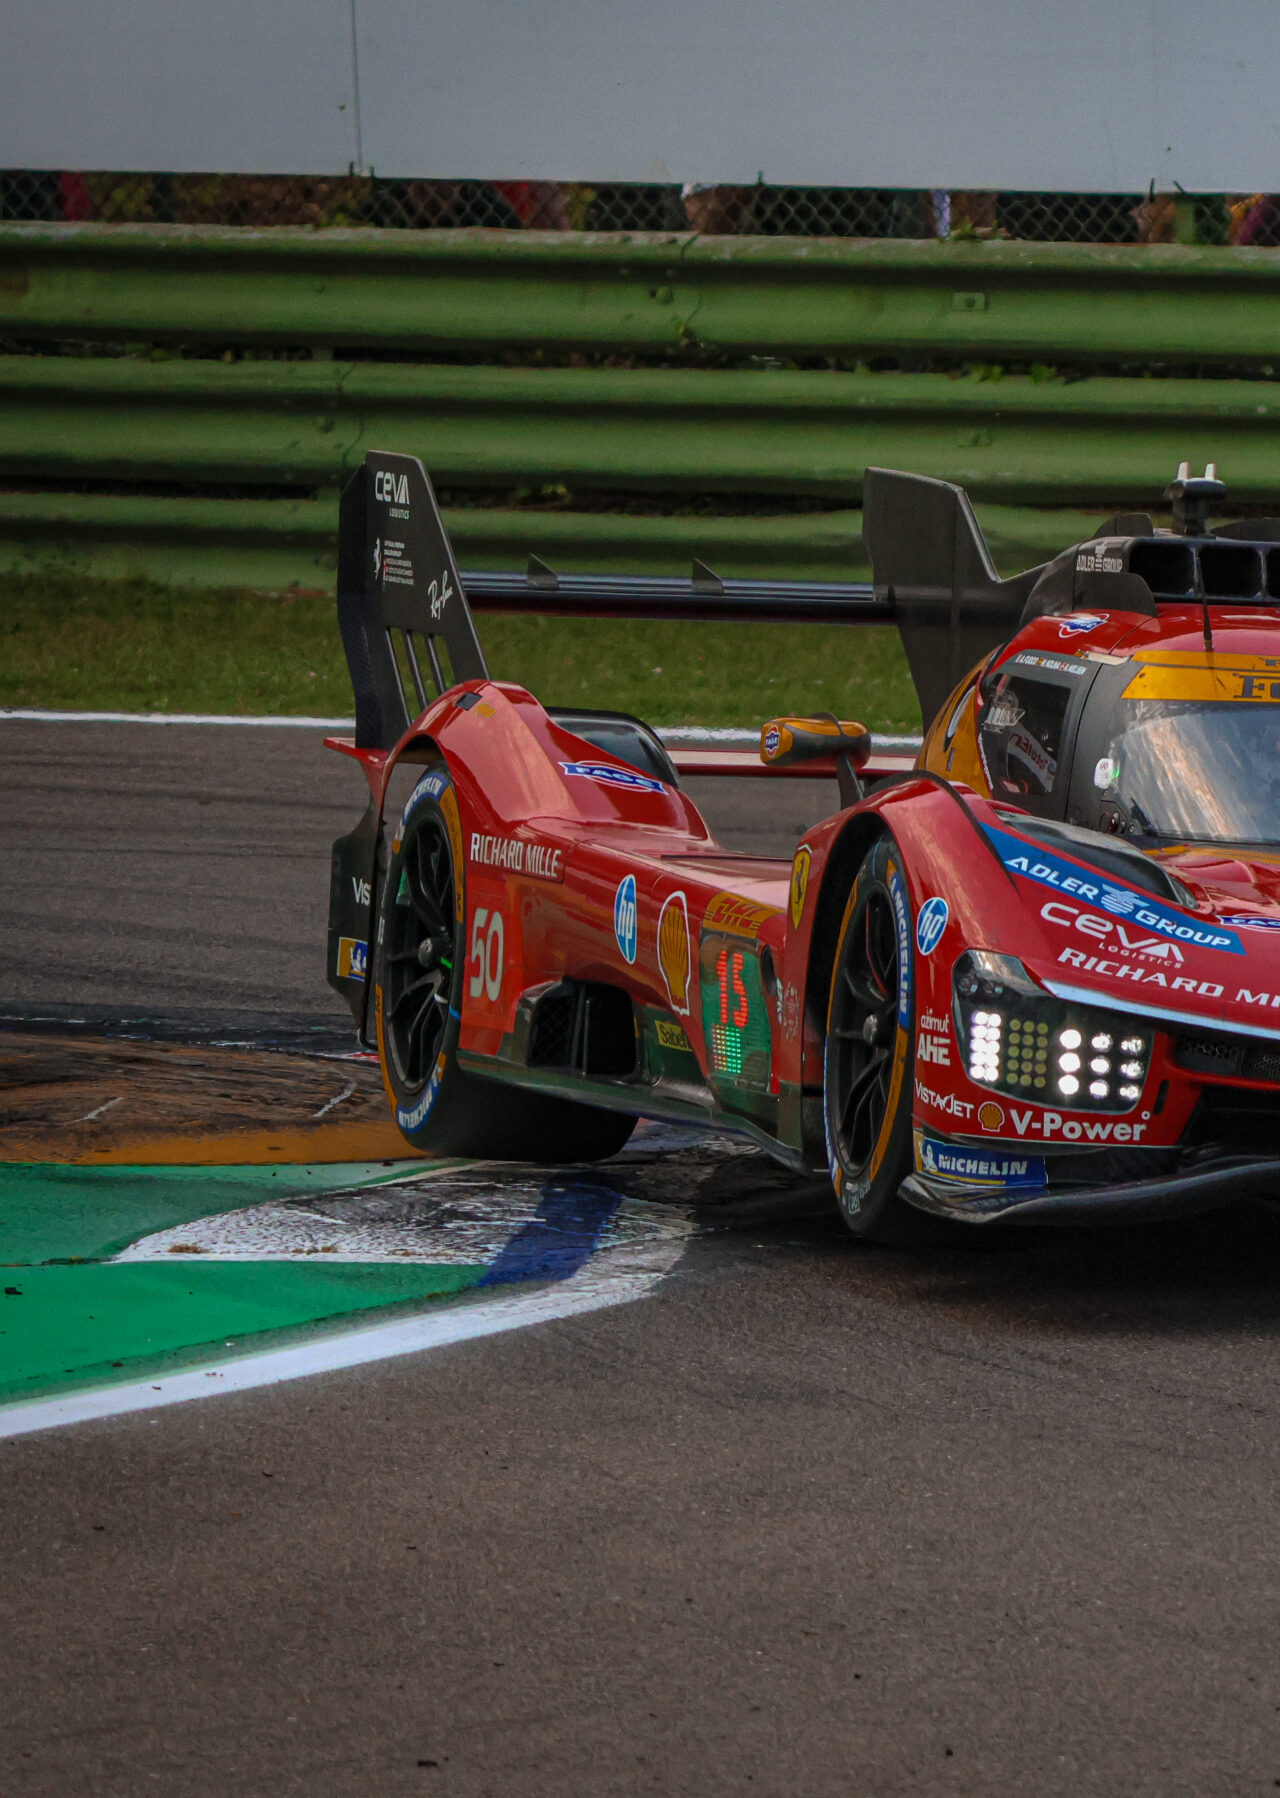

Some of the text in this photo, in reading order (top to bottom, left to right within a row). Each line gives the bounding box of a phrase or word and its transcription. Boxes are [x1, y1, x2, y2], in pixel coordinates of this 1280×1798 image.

[1076, 555, 1123, 573] ADLER GROUP
[470, 832, 562, 878] RICHARD MILLE
[1004, 856, 1232, 947] ADLER GROUP
[919, 899, 947, 953] hp
[469, 907, 503, 1001] 50
[1057, 947, 1225, 998] RICHARD
[1098, 942, 1182, 969] LOGISTICS
[1010, 1110, 1147, 1141] V-Power
[938, 1153, 1027, 1176] MICHELIN
